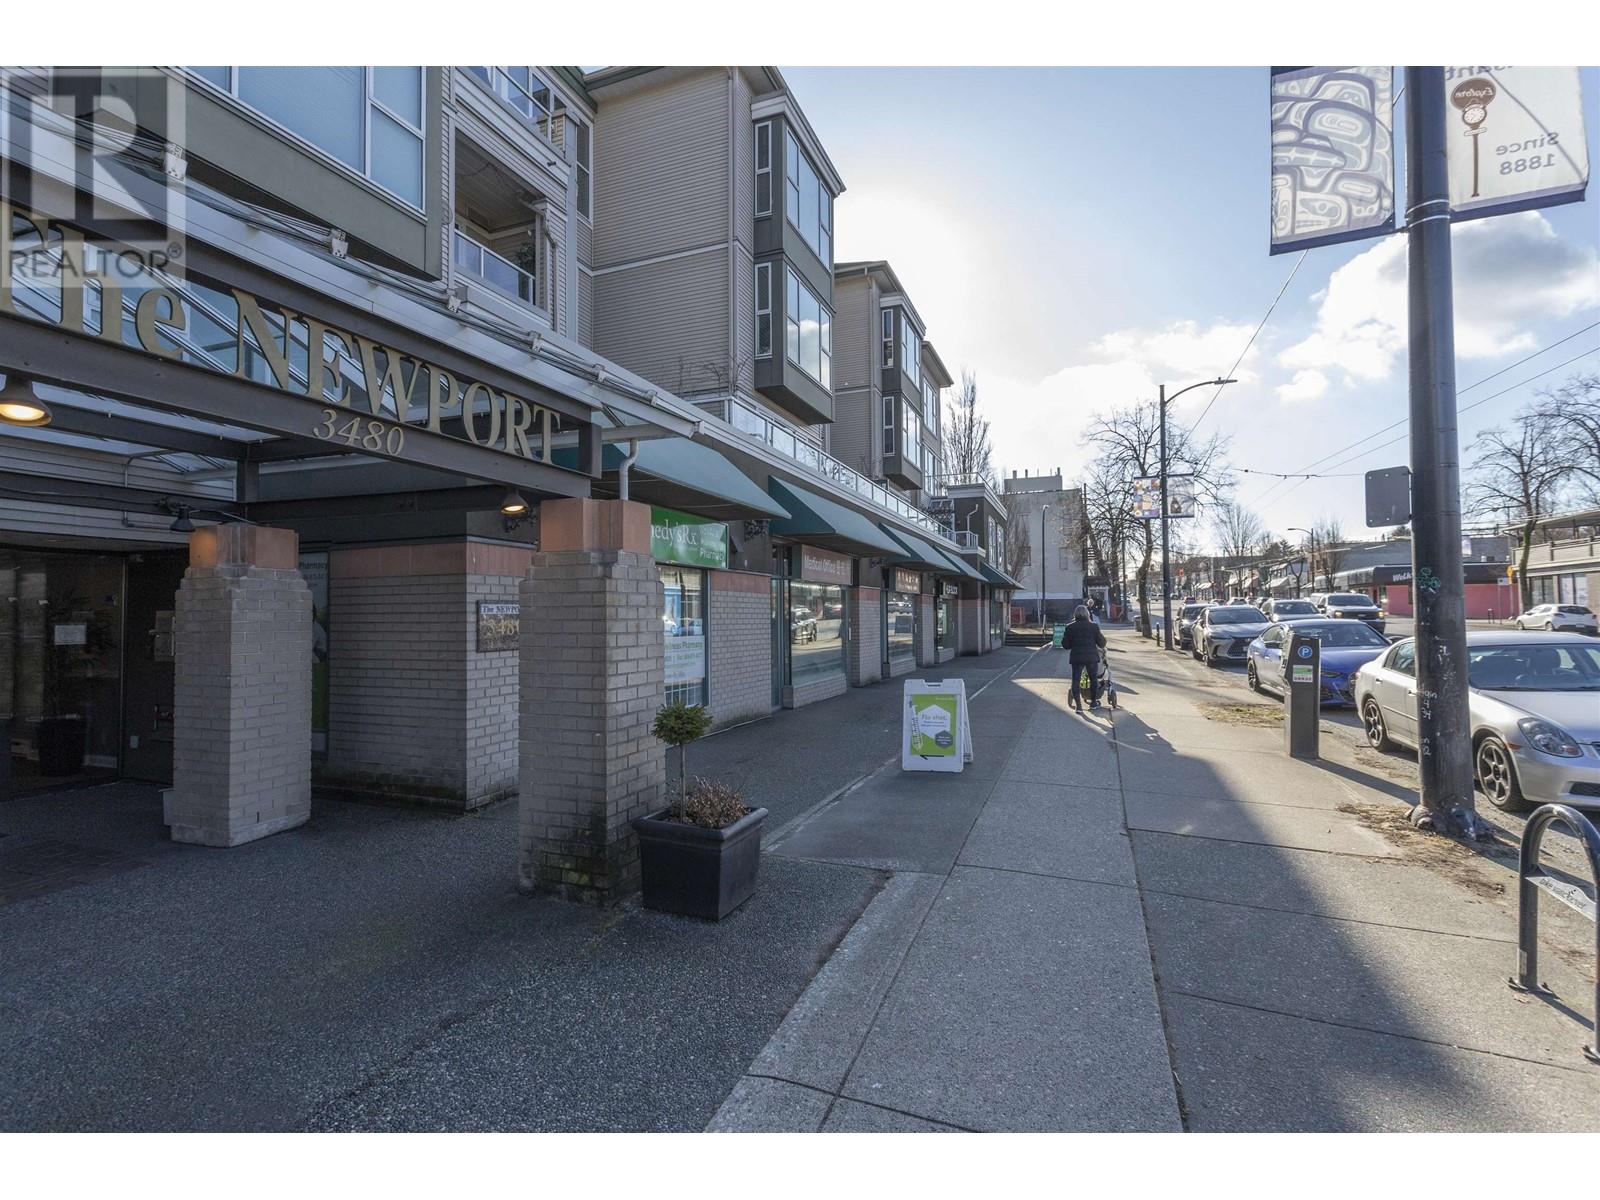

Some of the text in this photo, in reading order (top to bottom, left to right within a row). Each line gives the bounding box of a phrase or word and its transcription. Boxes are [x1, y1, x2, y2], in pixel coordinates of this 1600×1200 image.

[231, 288, 561, 466] NEWPORT
[313, 408, 405, 457] 3480
[482, 605, 494, 613] The
